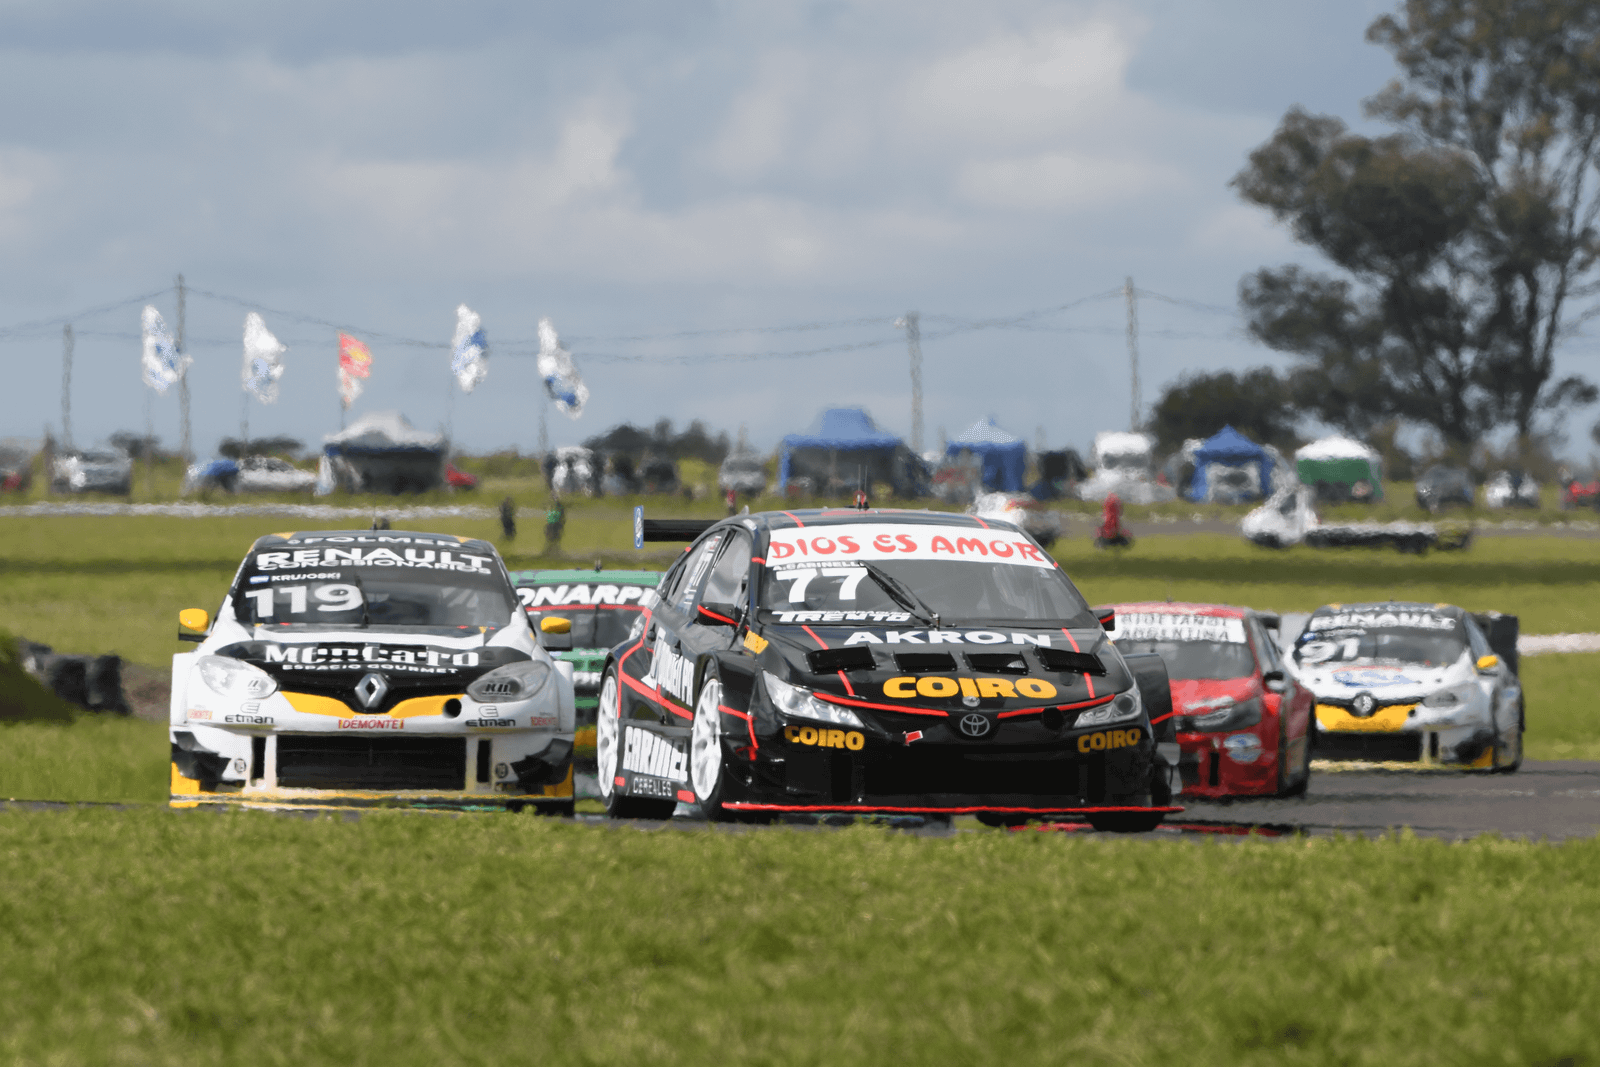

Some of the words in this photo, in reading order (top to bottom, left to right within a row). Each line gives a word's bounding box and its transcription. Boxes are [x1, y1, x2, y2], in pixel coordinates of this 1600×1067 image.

[304, 536, 461, 547] FOLMER
[770, 536, 860, 559] DIOS
[873, 534, 918, 553] ES
[931, 536, 1044, 561] AMOR
[257, 548, 492, 568] RENAULT
[258, 559, 491, 574] CONCESIONARIOS
[271, 572, 341, 581] KRUJOSKI
[776, 567, 868, 603] 77
[245, 583, 363, 618] 119
[844, 631, 1051, 647] AKRON
[367, 664, 458, 673] GOURMET
[883, 676, 1057, 698] COIRO
[342, 719, 399, 729] DEMONTE
[784, 726, 865, 750] COIRO
[1077, 729, 1141, 753] COIRO
[633, 777, 672, 797] CEREALES
